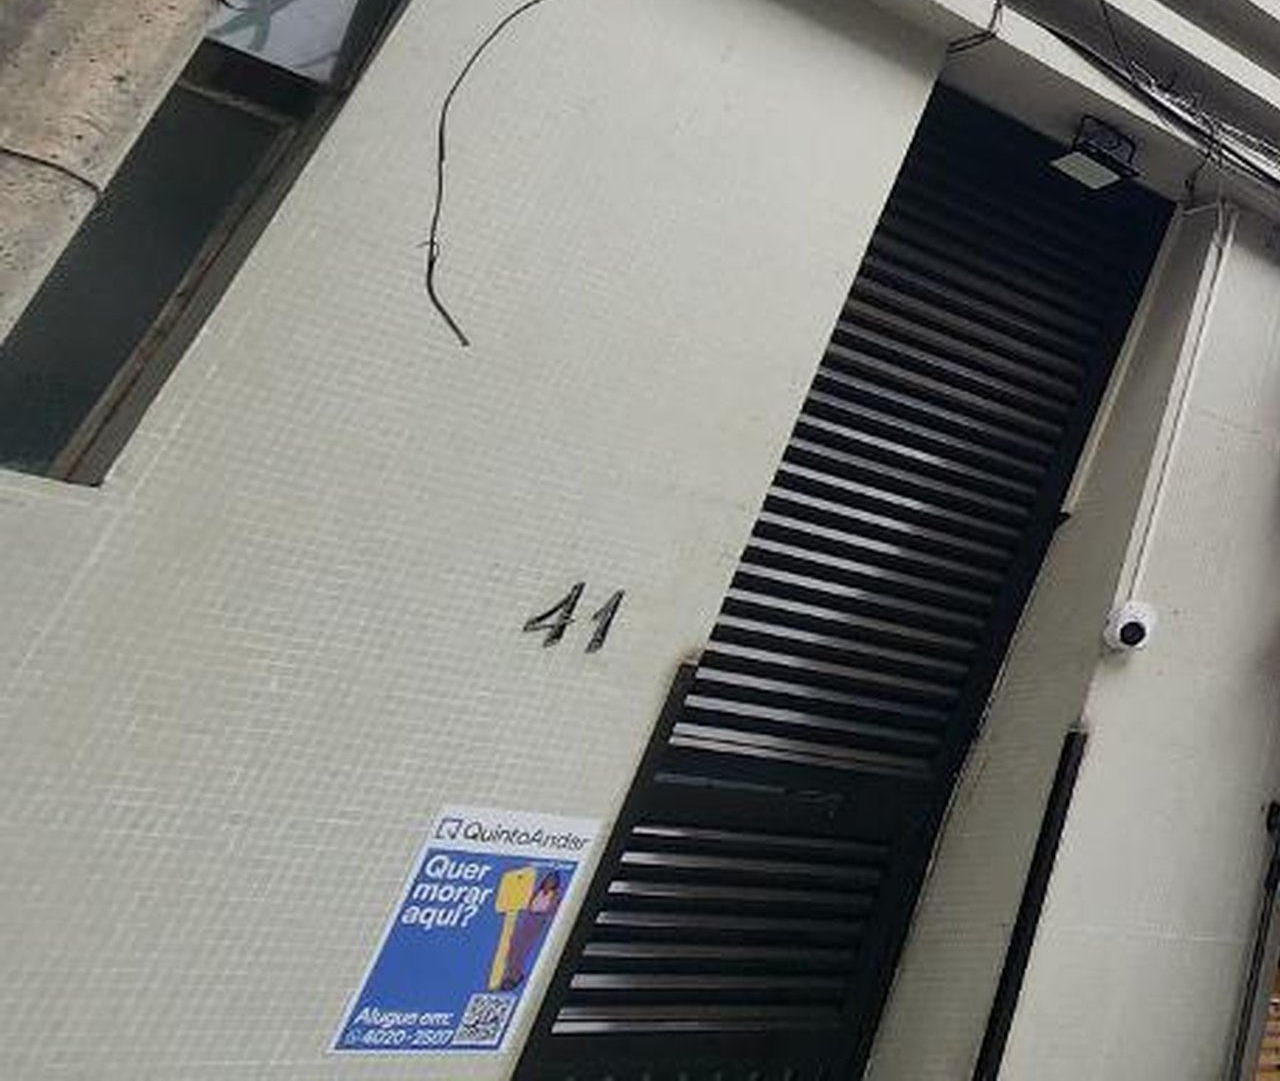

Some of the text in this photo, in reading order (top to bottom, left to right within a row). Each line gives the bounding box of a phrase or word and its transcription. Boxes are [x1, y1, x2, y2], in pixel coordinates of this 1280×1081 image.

[523, 581, 626, 654] 41
[463, 821, 592, 850] QuintoAndar
[425, 855, 491, 881] Quer
[412, 880, 493, 905] morar
[402, 903, 478, 931] aqui?
[353, 1007, 417, 1028] Alugue
